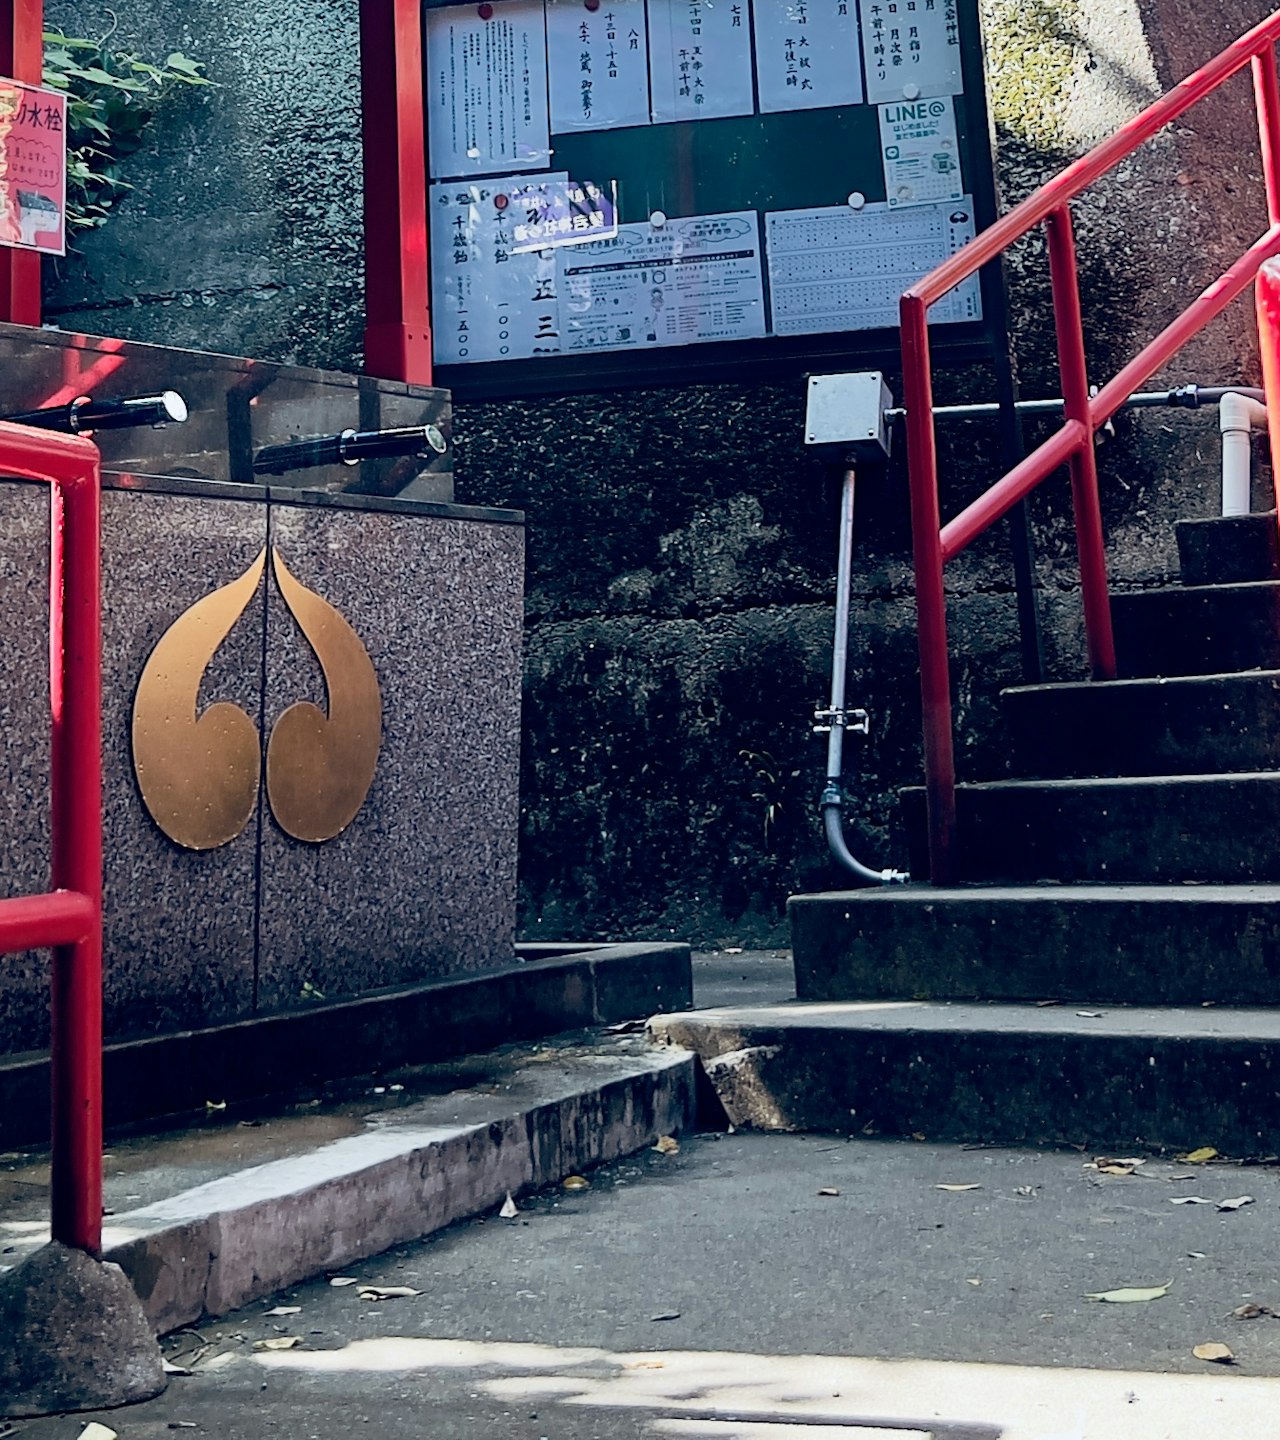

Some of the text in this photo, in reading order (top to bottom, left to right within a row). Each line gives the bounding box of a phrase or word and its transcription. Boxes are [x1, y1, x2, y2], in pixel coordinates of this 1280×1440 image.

[730, 4, 741, 27] 七月
[628, 28, 639, 50] 八月
[871, 5, 886, 80] 午前十時より
[678, 49, 691, 96] 午前十時
[785, 38, 797, 86] 午後三時
[885, 101, 945, 123] LINE@
